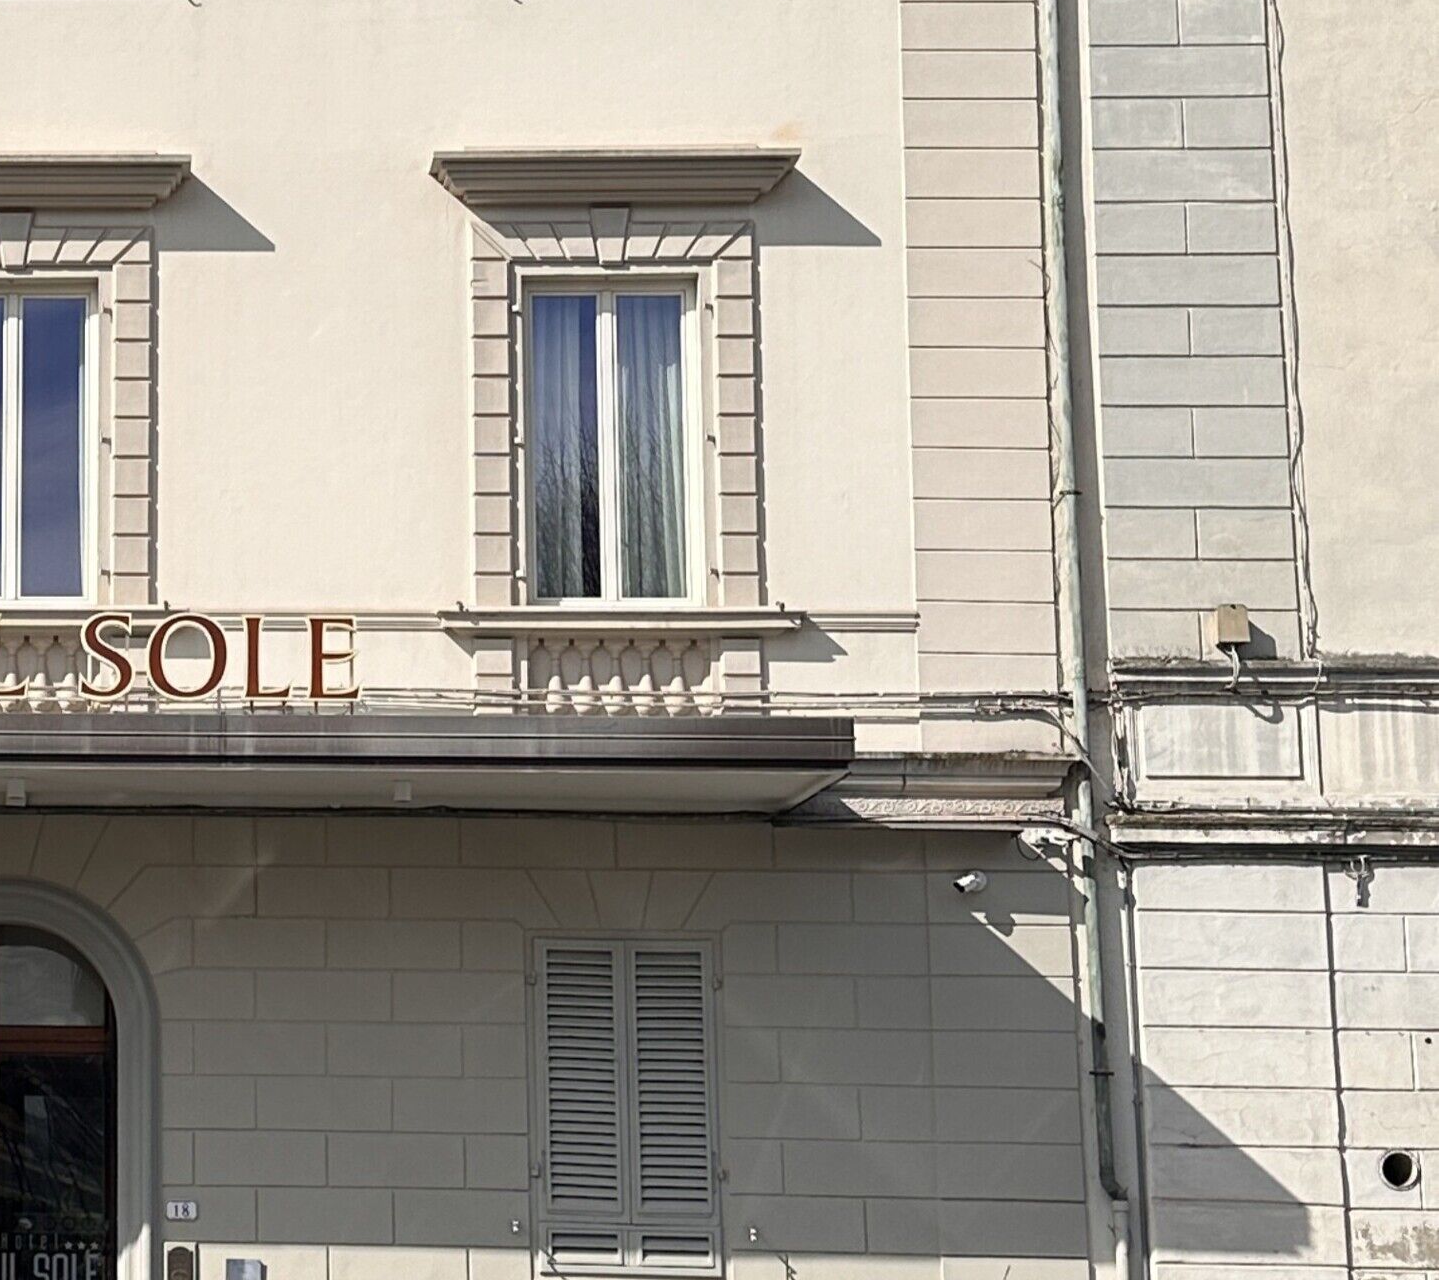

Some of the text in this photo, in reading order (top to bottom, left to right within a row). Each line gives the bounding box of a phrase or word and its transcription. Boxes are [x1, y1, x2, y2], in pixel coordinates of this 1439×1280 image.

[78, 612, 364, 702] SOLE
[174, 1204, 190, 1217] 18
[1, 1233, 59, 1250] Hotel
